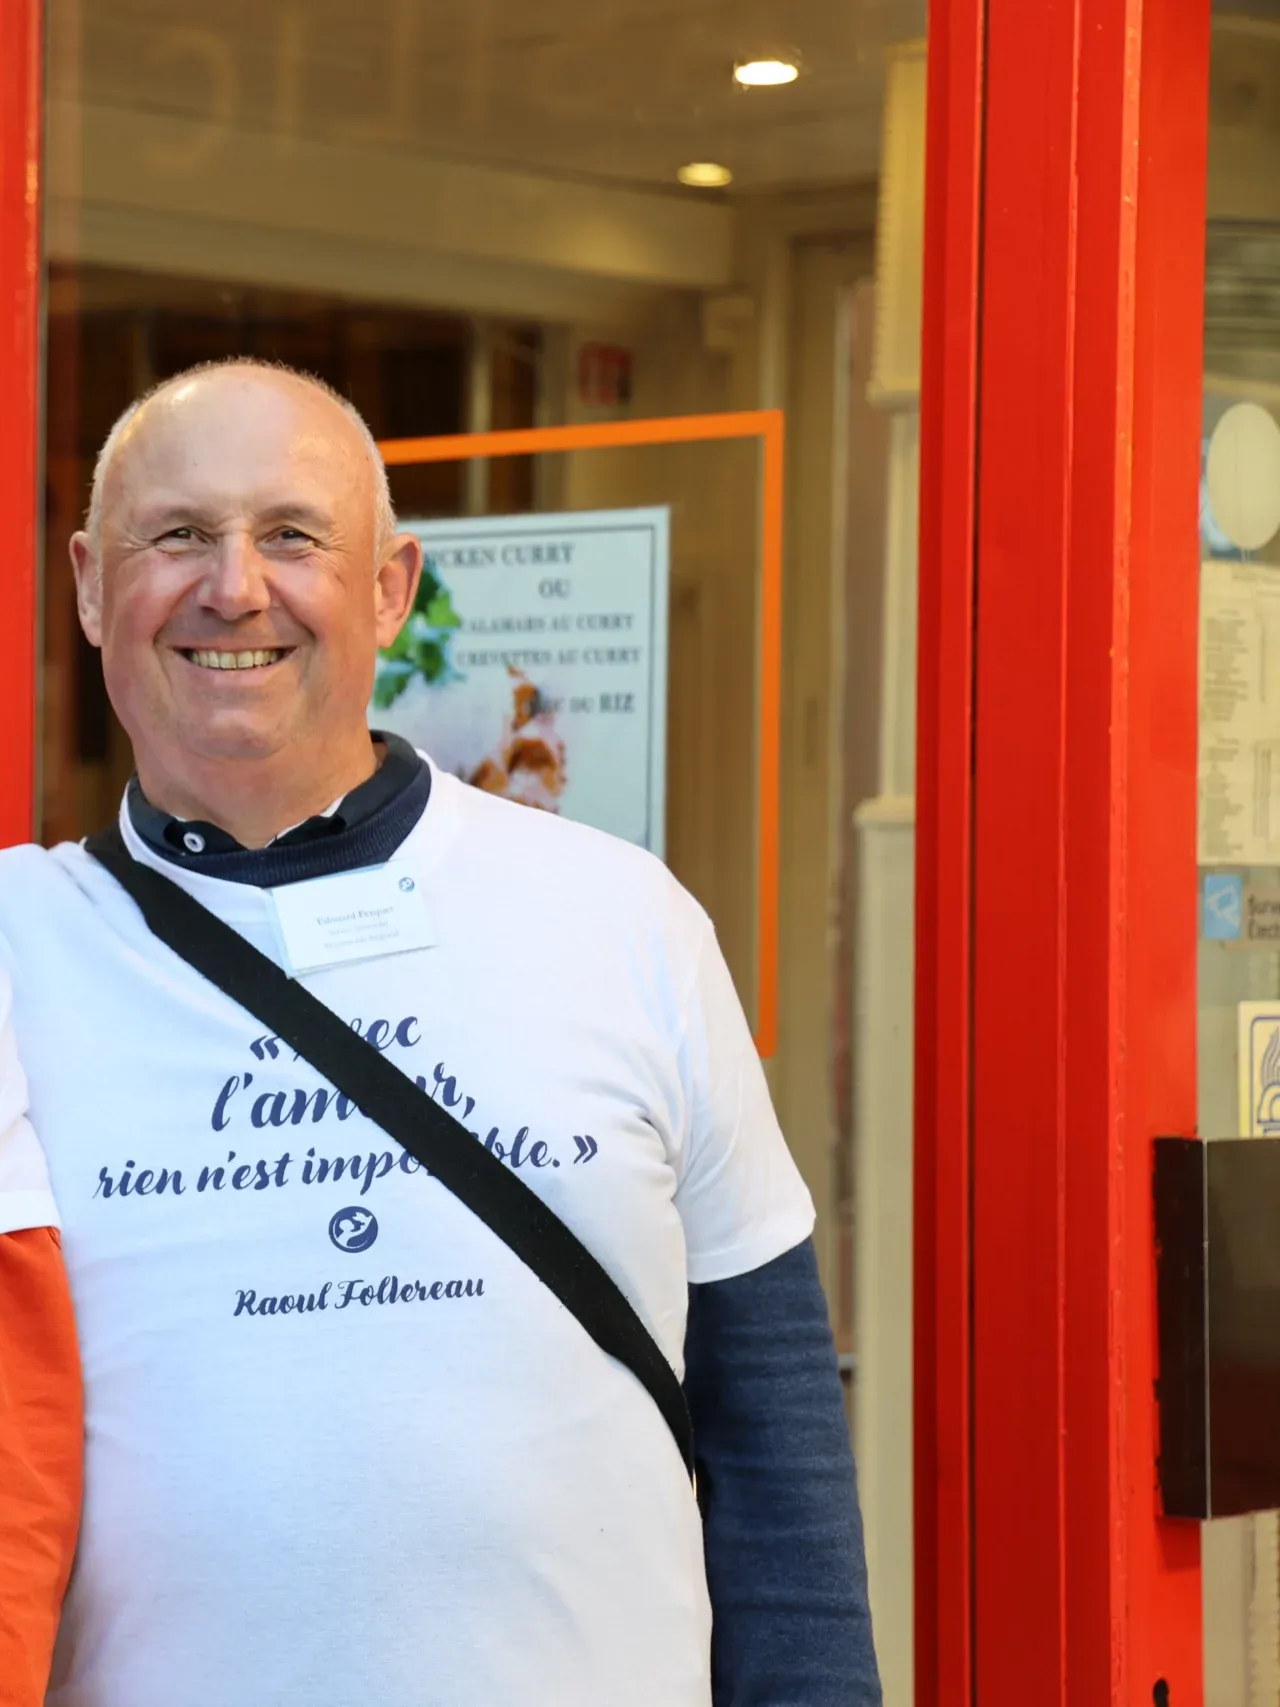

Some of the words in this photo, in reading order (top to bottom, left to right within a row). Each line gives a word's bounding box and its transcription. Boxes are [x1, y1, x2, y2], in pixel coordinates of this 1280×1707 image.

[500, 543, 574, 566] CURRY
[538, 577, 570, 599] OU
[576, 613, 634, 632] CURRY
[582, 646, 640, 665] CURRY
[599, 692, 636, 714] RIZ
[293, 1016, 422, 1062] ec
[211, 1062, 476, 1133] l'amr,
[94, 1159, 187, 1199] rien
[196, 1150, 294, 1193] n'est
[233, 1281, 332, 1317] Raoul
[333, 1275, 485, 1310] Follereau
